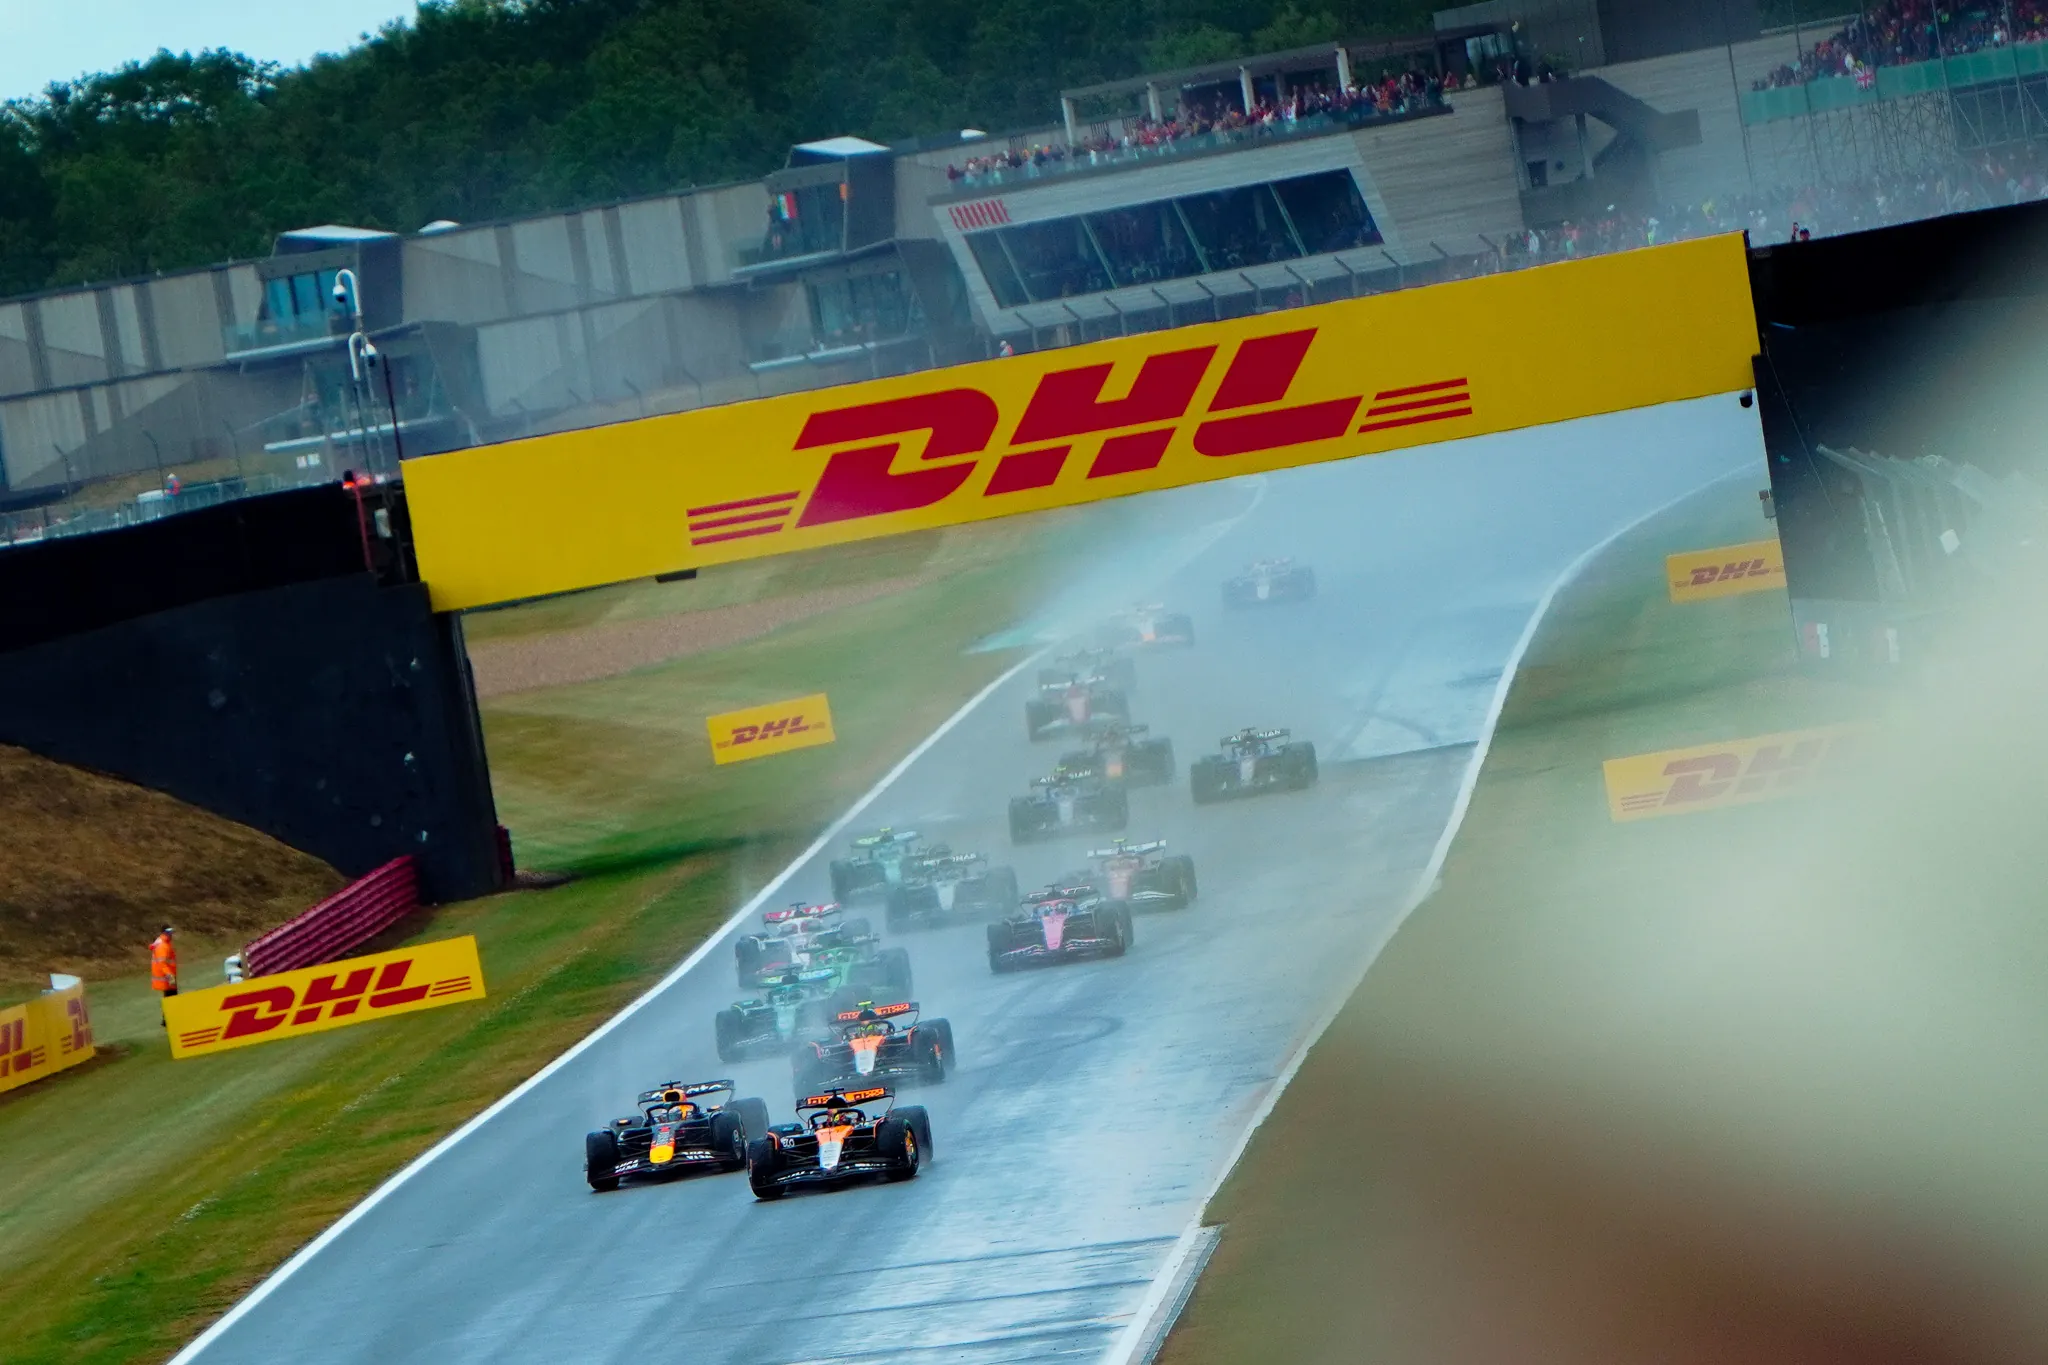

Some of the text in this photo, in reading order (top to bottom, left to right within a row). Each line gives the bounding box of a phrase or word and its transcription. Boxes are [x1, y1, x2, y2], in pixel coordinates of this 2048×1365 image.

[793, 327, 1364, 529] DHL
[1690, 558, 1771, 586] DHL
[731, 715, 810, 746] DHL
[219, 959, 431, 1040] DHL
